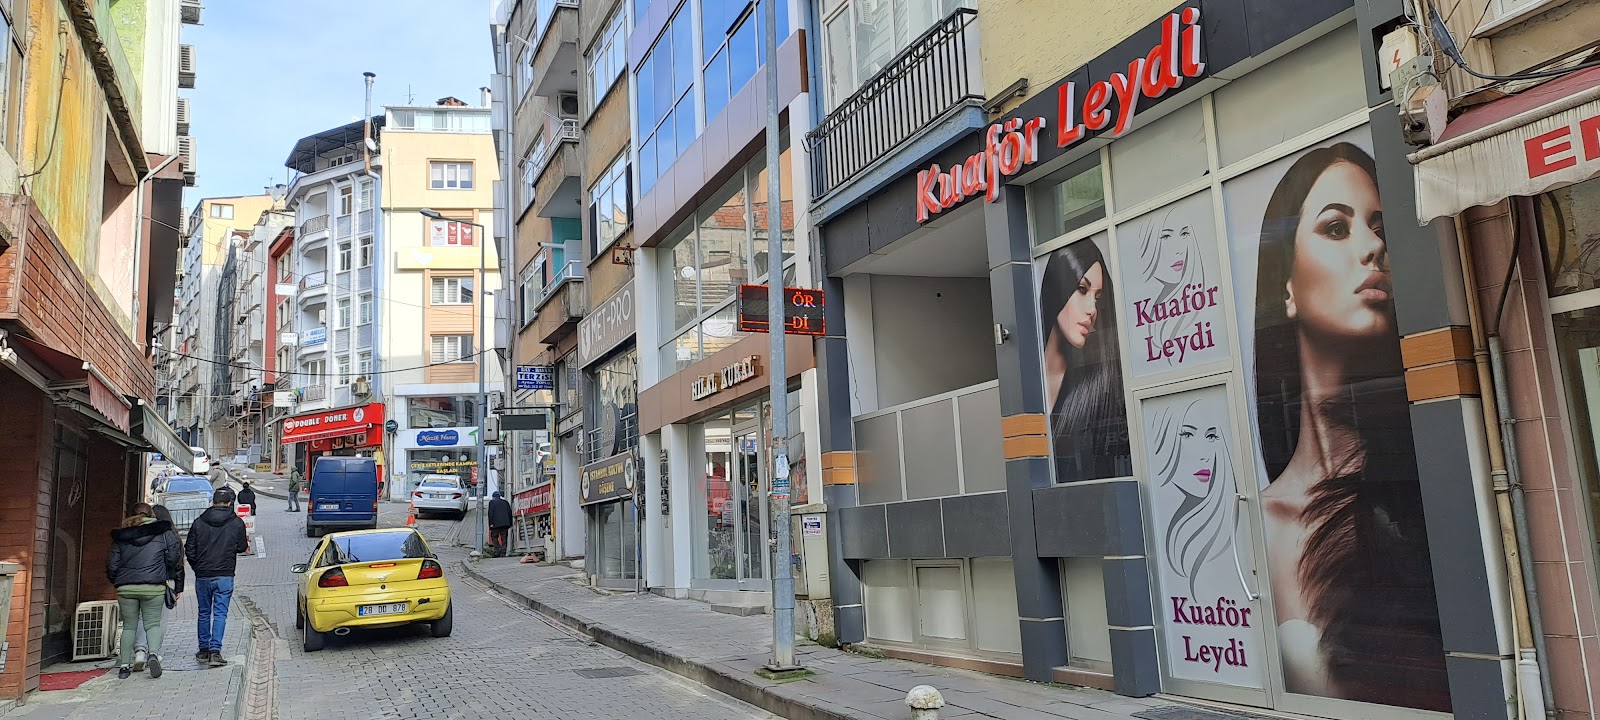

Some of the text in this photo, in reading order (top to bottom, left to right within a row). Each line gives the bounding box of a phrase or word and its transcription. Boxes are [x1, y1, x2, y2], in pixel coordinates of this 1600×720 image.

[916, 7, 1205, 223] Kuaför Leydi
[591, 289, 632, 345] MET-PRO
[792, 291, 816, 308] ÖR
[1133, 283, 1218, 327] Kuaför
[1144, 321, 1215, 363] Leydi
[720, 356, 755, 389] KURAL
[295, 413, 348, 428] DOUBLE DÖNER
[392, 603, 406, 612] 878
[1170, 596, 1251, 628] Kuaför
[1182, 635, 1248, 673] Leydi
